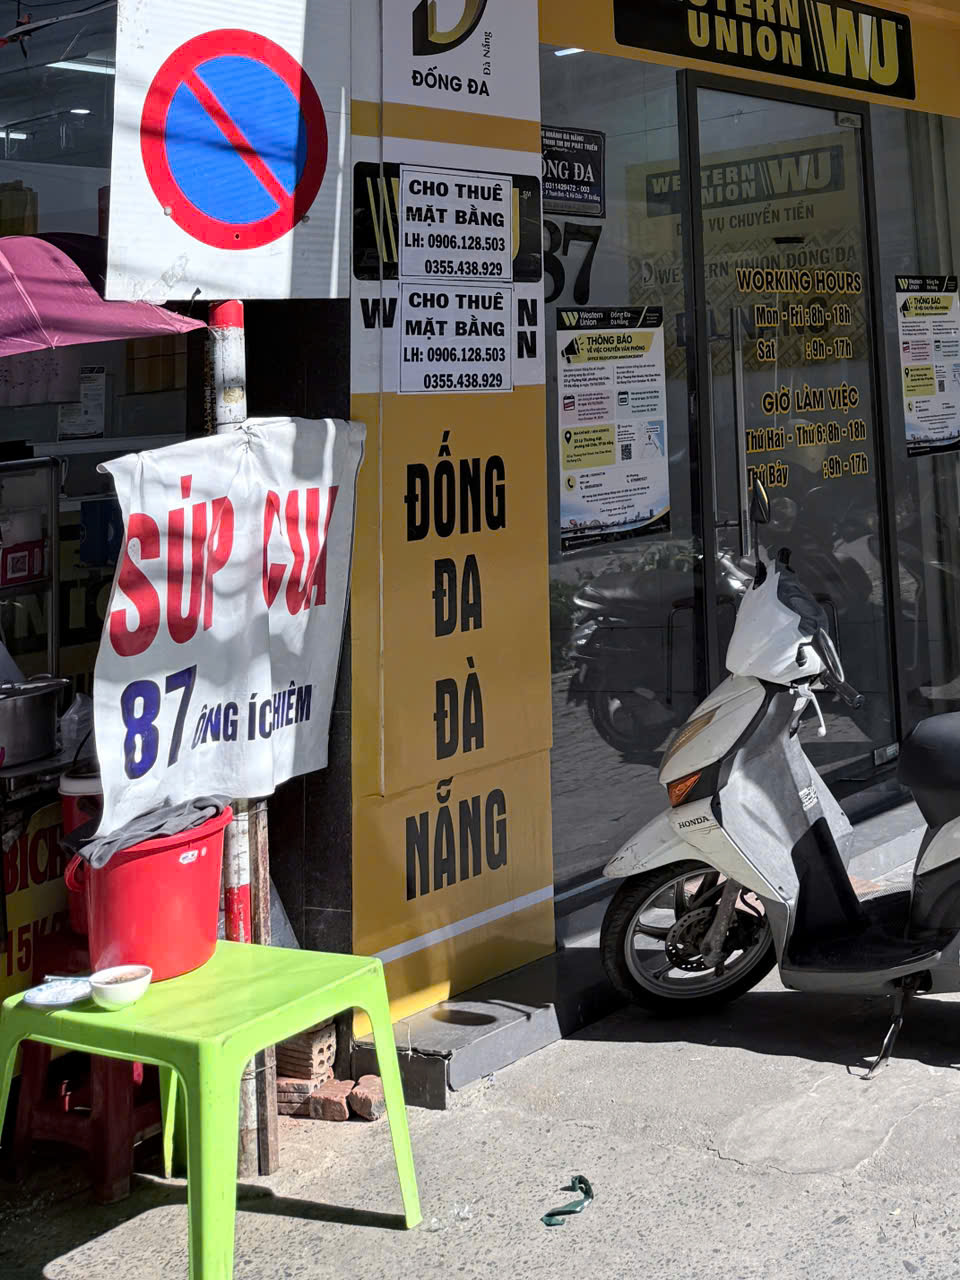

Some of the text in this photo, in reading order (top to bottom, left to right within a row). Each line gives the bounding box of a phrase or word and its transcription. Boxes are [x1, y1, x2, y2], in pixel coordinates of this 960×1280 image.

[687, 9, 802, 66] UNION
[816, 1, 900, 86] WU
[411, 66, 490, 97] ĐỐNG ĐA
[573, 162, 595, 182] ĐA
[408, 179, 504, 203] CHO THUÊ
[405, 202, 505, 228] MẶT BẰNG
[404, 234, 506, 252] LH: 0906.128.503
[424, 259, 503, 277] 0355.438.929
[736, 268, 863, 293] WORKING HOURS
[408, 291, 449, 311] CHO
[455, 289, 504, 313] THUÊ
[405, 314, 505, 341] MẶT BẰNG
[755, 305, 778, 327] Mon
[833, 305, 851, 326] 18h
[587, 333, 632, 345] THÔNG BÁO
[757, 337, 853, 361] Sat 17h
[403, 346, 506, 364] LH: 0906.128.503
[423, 371, 503, 389] 0355.438.929
[762, 380, 860, 414] GIỜ LÀM VIỆC
[745, 419, 866, 453] Thứ Hai Thứ 18h
[768, 460, 789, 488] Bảy
[850, 453, 868, 477] 17h
[404, 430, 507, 542] ĐỐNG
[108, 474, 234, 658] SÚP
[432, 553, 483, 638] ĐA
[433, 657, 485, 761] ĐÀ
[121, 665, 238, 780] 87 ÔNG
[678, 814, 710, 831] HONDA
[405, 776, 508, 901] NẴNG
